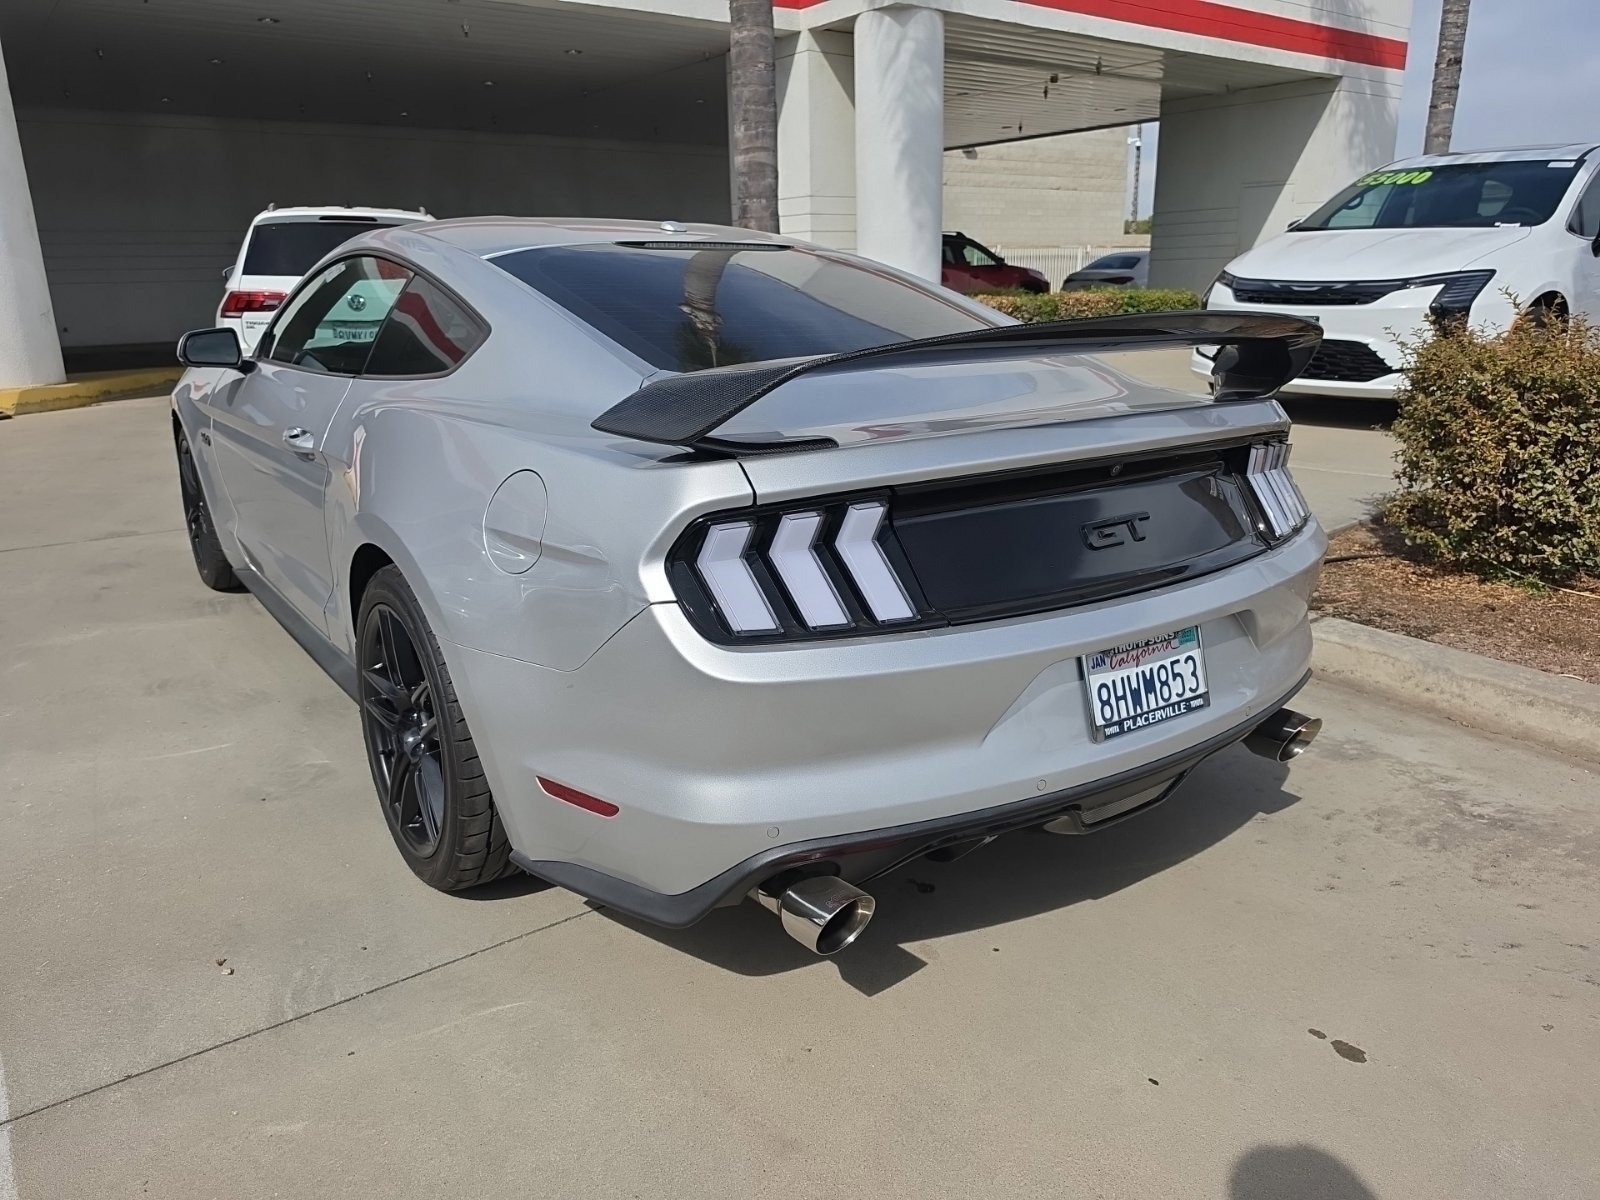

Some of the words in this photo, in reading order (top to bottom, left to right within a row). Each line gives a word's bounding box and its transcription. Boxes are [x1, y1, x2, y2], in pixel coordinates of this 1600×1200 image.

[1080, 511, 1151, 551] GT
[1091, 654, 1106, 670] JAN
[1110, 640, 1181, 670] California
[1097, 655, 1200, 724] 8HWM853
[1123, 702, 1188, 732] PLACERVILLE
